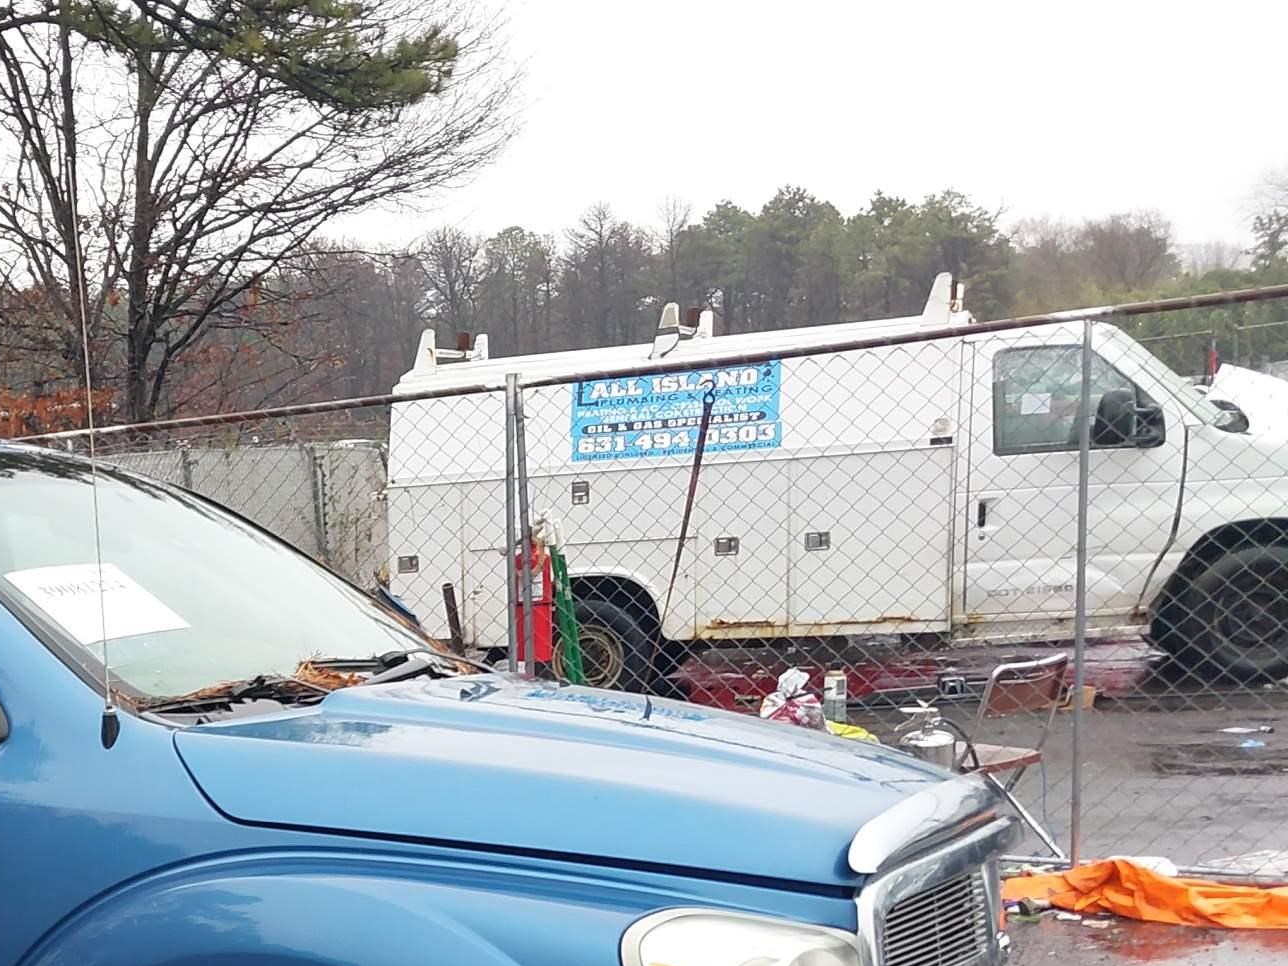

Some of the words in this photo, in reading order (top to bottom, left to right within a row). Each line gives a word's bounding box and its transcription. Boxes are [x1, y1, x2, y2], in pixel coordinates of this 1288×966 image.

[589, 379, 644, 398] ALL
[651, 367, 759, 394] ISLAND
[600, 394, 679, 407] PLUMBING
[655, 403, 747, 418] CONSTRCTION
[587, 424, 613, 434] OIL
[633, 420, 663, 431] GAS
